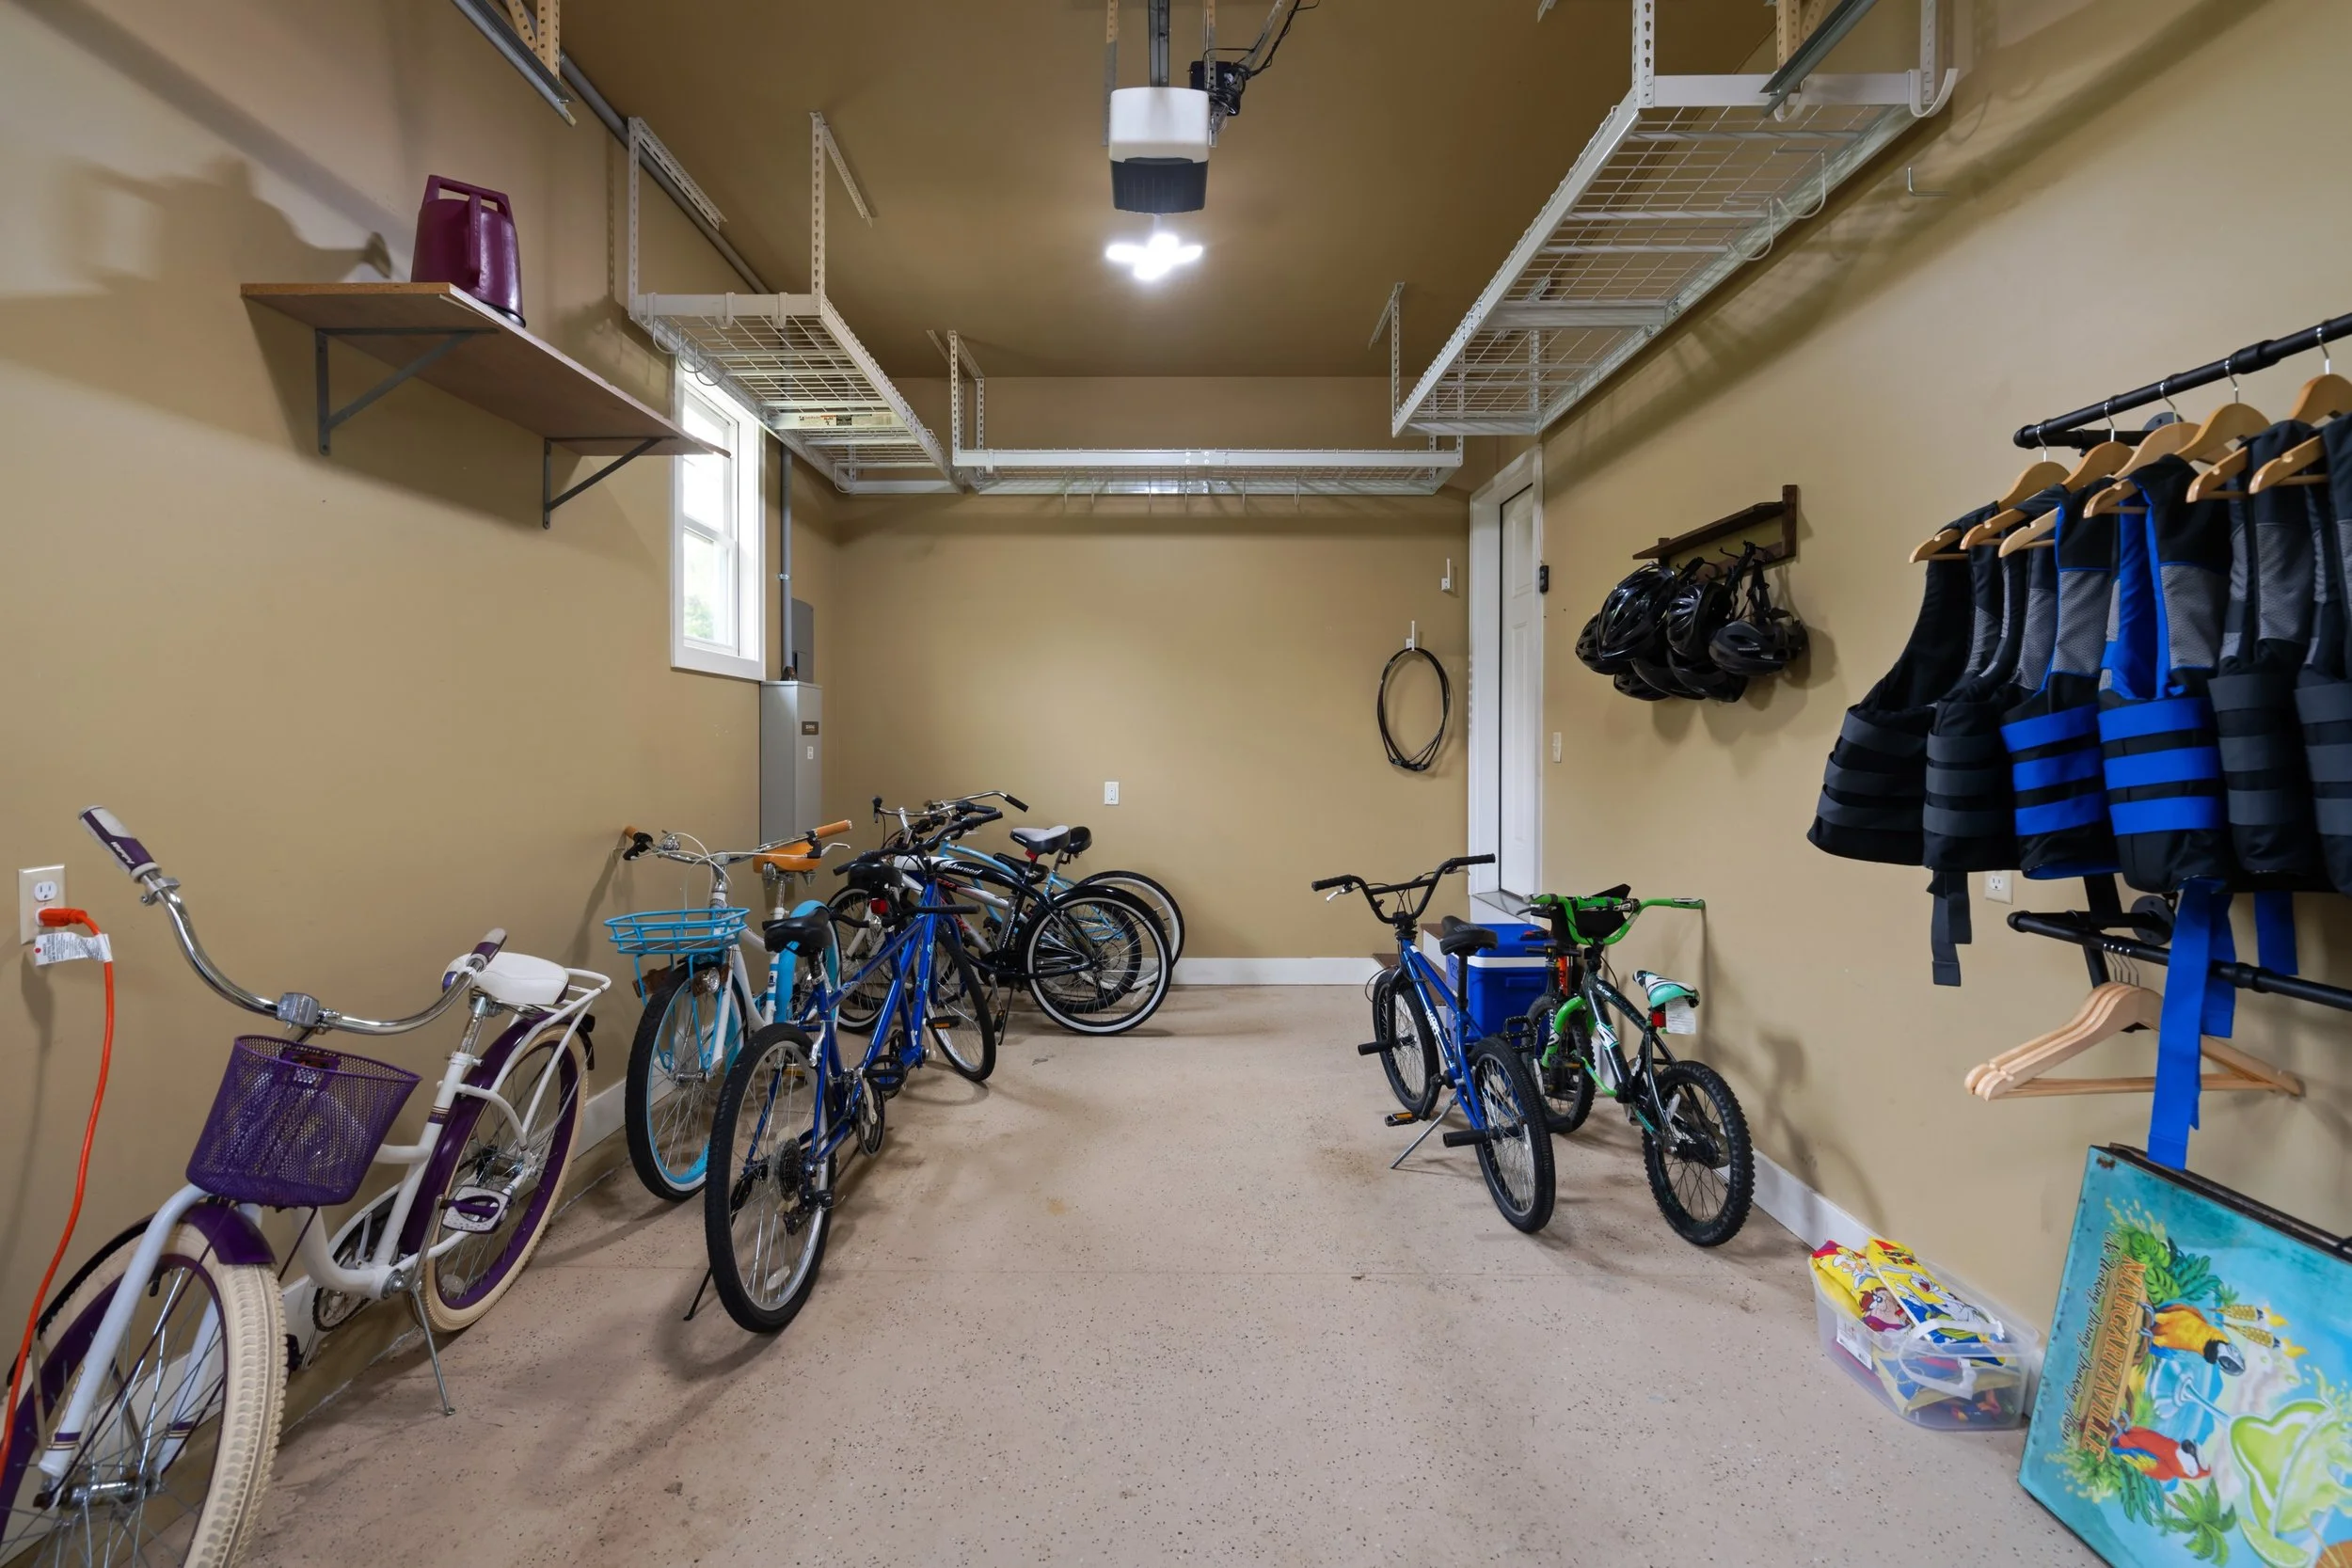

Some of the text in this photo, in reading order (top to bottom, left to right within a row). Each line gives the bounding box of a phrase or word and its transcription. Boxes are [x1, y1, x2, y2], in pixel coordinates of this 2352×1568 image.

[2103, 1231, 2121, 1254] No
[2081, 1254, 2145, 1461] MARGARITAVILLE
[2062, 1405, 2080, 1442] Hours
